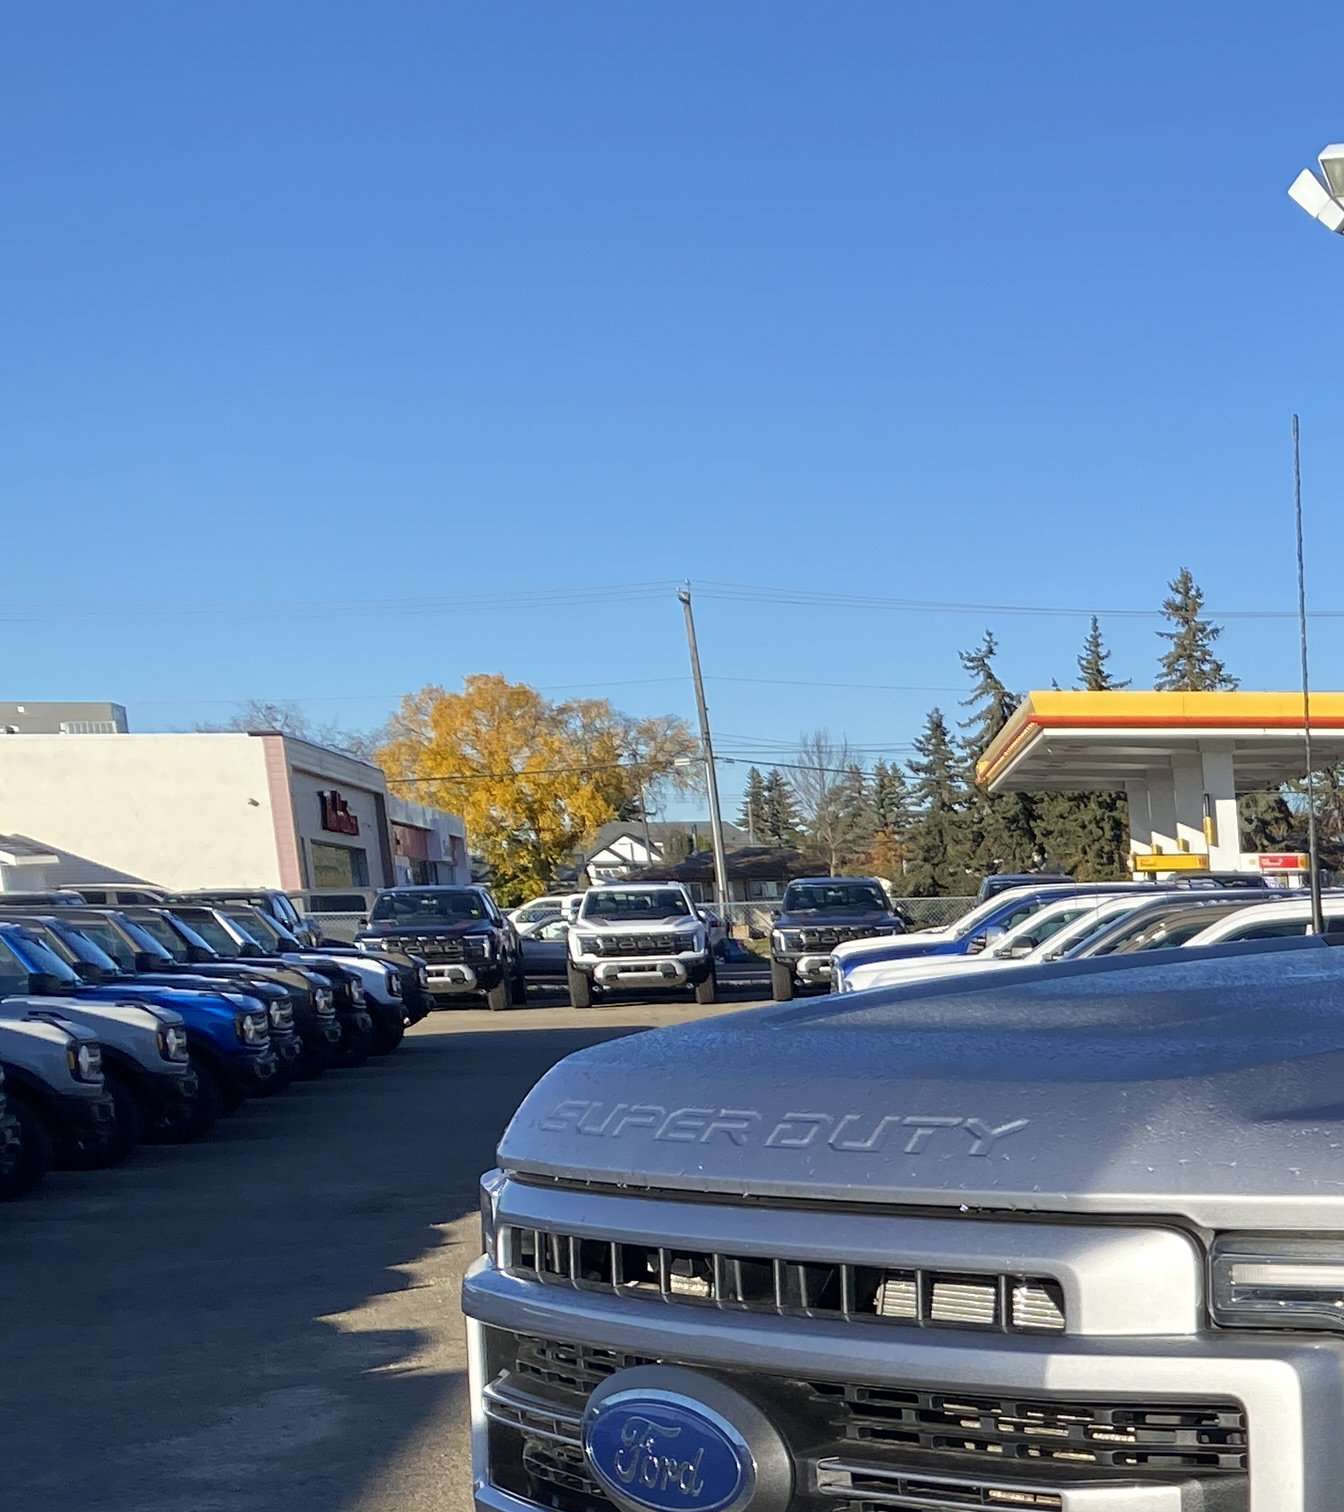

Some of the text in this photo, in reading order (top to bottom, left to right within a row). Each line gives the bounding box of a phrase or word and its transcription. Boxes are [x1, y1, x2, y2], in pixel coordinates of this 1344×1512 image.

[541, 1100, 1030, 1157] SUPER DUTY
[614, 1416, 704, 1497] Ford
